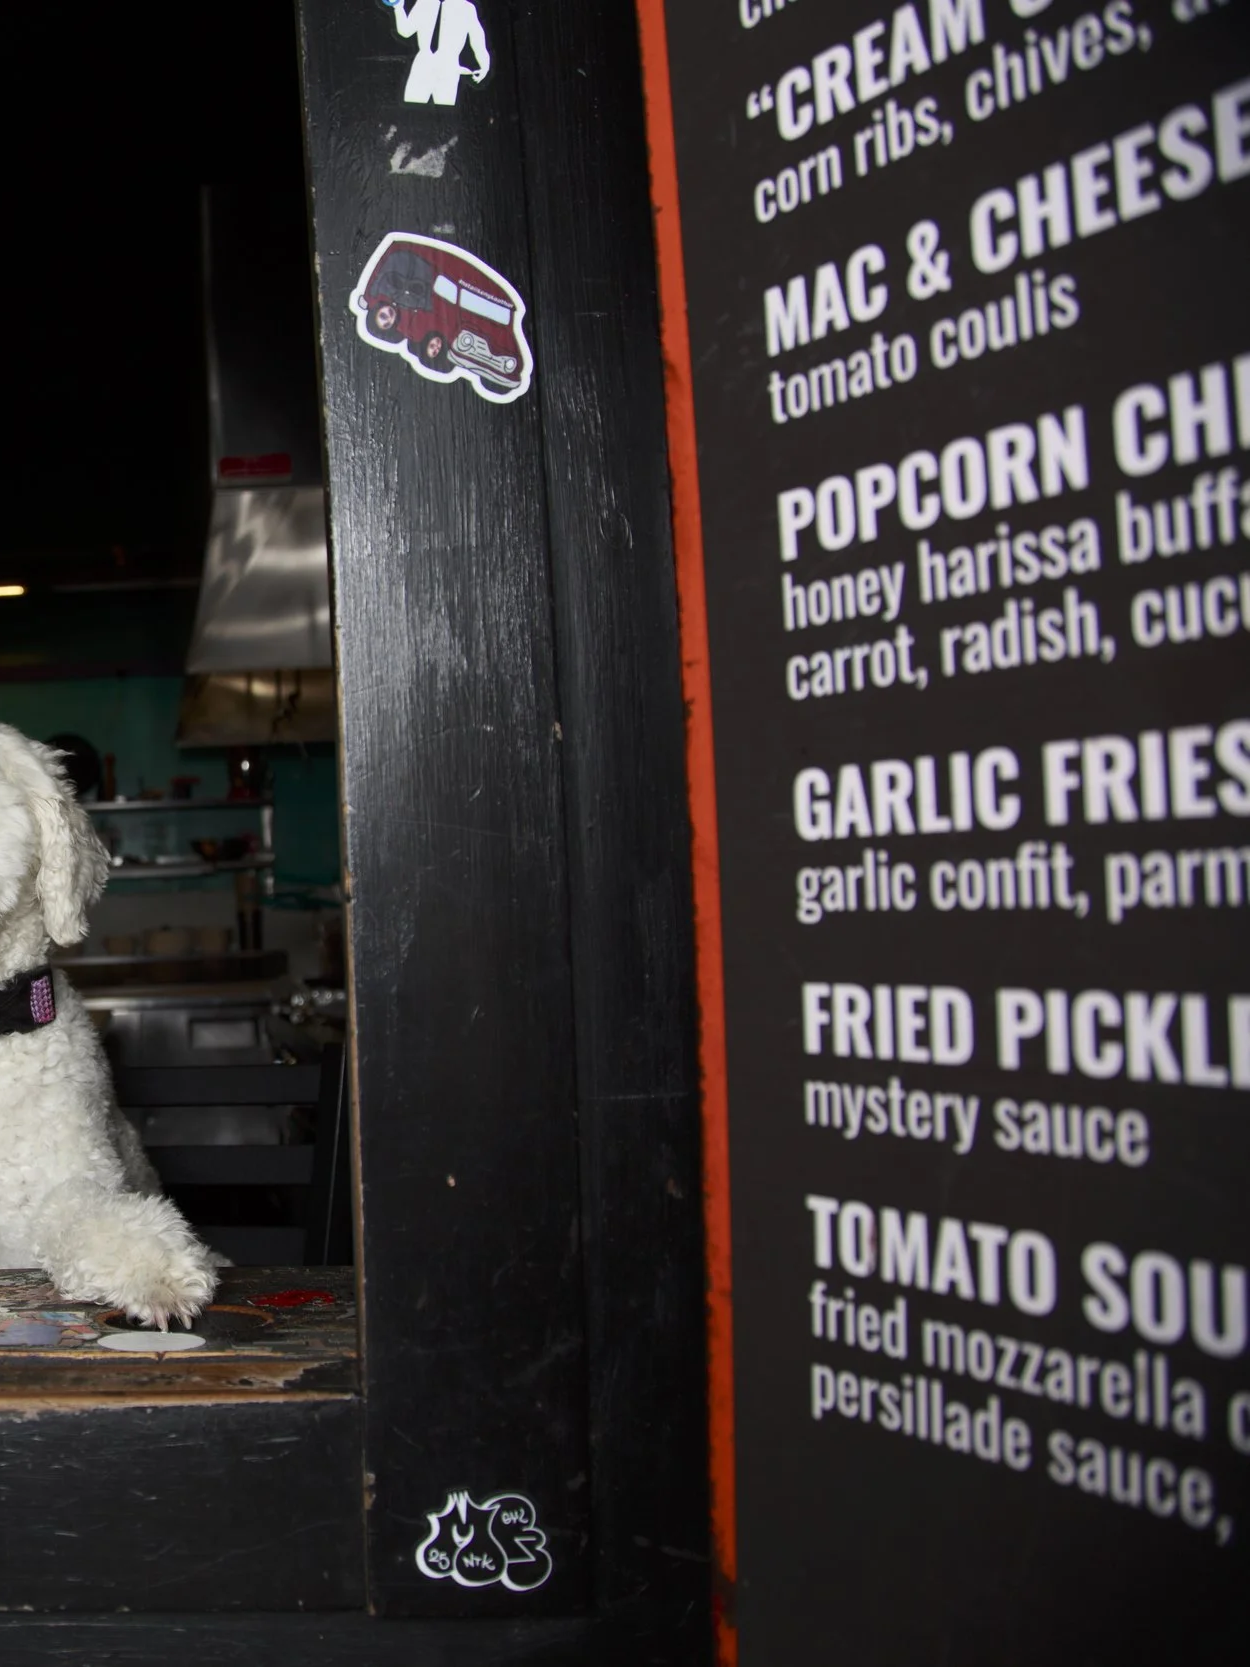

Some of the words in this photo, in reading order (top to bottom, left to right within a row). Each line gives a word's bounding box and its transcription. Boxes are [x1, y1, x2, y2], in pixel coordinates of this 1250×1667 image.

[754, 145, 843, 223] corn
[853, 97, 953, 177] ribs,
[965, 0, 1152, 121] chives,
[763, 244, 888, 358] MAC
[906, 220, 952, 300] &
[969, 76, 1250, 274] CHEESE
[767, 332, 919, 424] tomato
[929, 269, 1080, 369] coulis
[777, 405, 1090, 562] POPCORN
[781, 561, 905, 632] honey
[917, 518, 1102, 604] harissa
[786, 624, 930, 701] carrot,
[940, 586, 1117, 677] radish,
[793, 746, 1022, 842] GARLIC
[1042, 718, 1250, 826] FRIES
[795, 848, 917, 925] garlic
[928, 841, 1090, 918] confit,
[802, 982, 975, 1066] FRIED
[804, 1076, 980, 1154] mystery
[993, 1098, 1150, 1167] sauce
[805, 1193, 1057, 1316] TOMATO
[1081, 1241, 1248, 1357] SOU
[809, 1279, 908, 1360] fried
[921, 1318, 1206, 1440] mozzarella
[811, 1363, 1032, 1472] persillade
[1047, 1429, 1233, 1546] sauce,
[428, 1549, 450, 1570] 25
[462, 1552, 496, 1571] NTK
